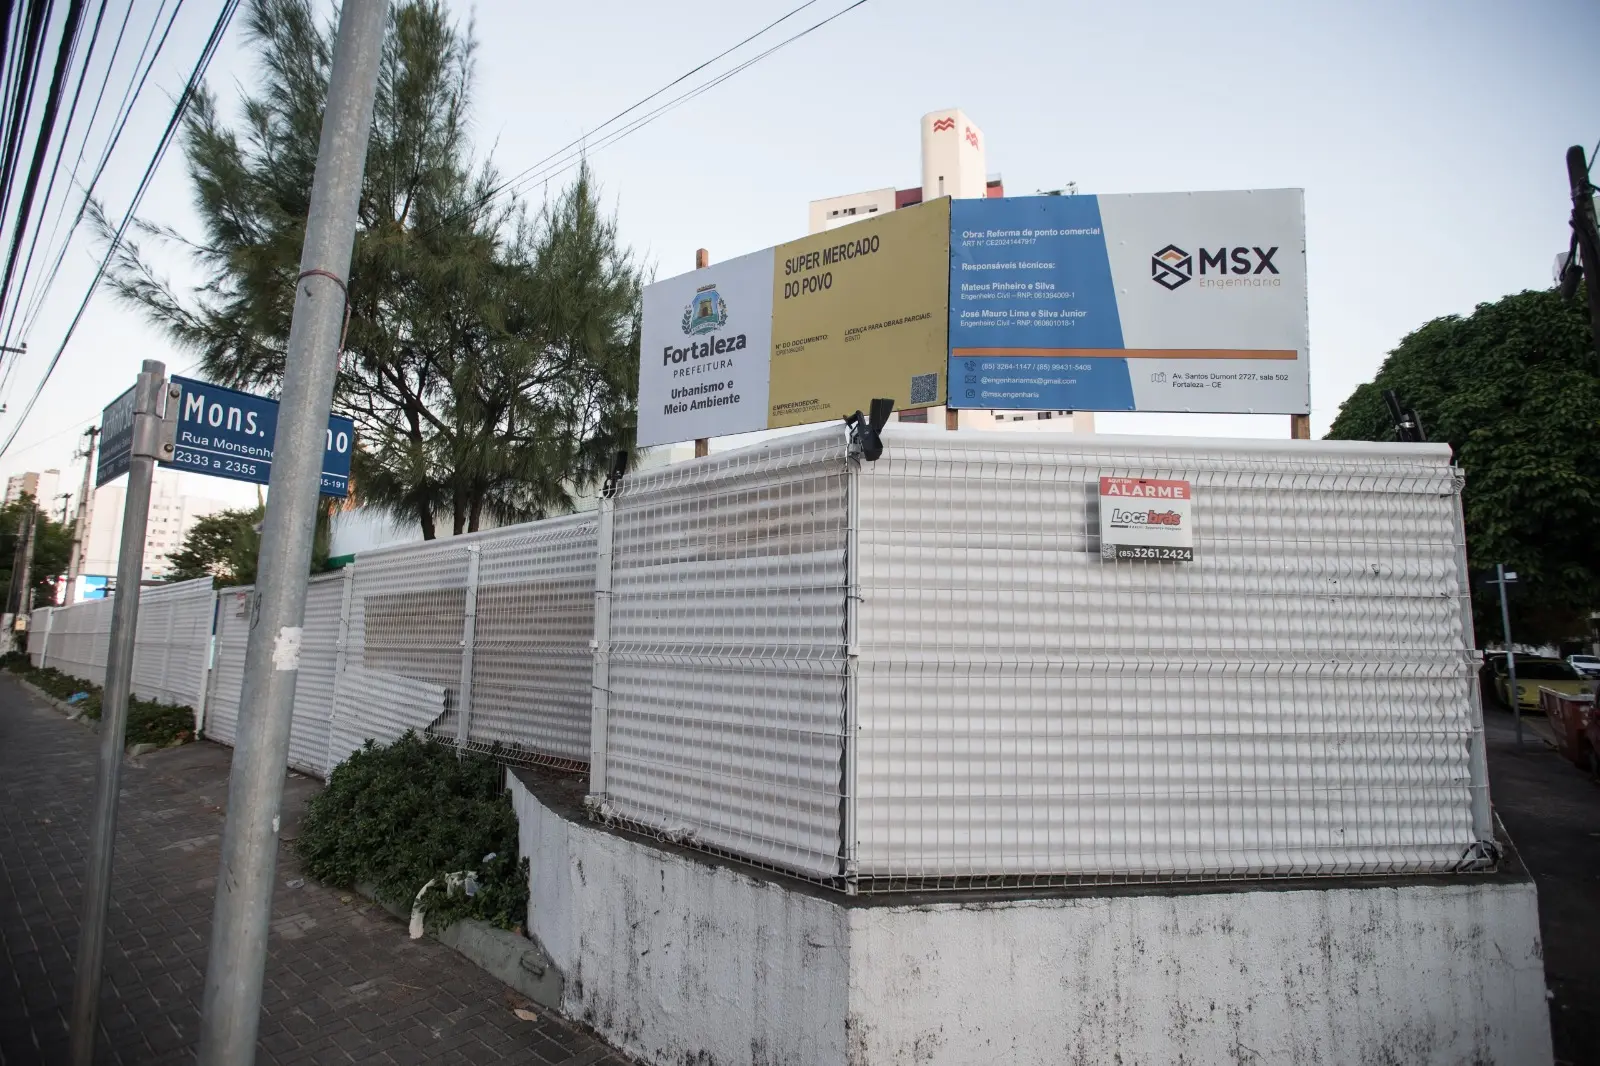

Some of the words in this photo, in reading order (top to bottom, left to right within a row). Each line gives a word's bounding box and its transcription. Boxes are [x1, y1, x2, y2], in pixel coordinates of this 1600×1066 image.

[962, 230, 984, 238] Obra:
[987, 229, 1020, 237] Reforma
[1034, 228, 1058, 238] ponto
[1060, 227, 1100, 236] comercial
[785, 251, 820, 276] SUPER
[823, 235, 880, 266] MERCADO
[1199, 246, 1280, 275] MSX
[962, 261, 1017, 271] Responsáveis
[1019, 261, 1056, 269] técnicos:
[784, 280, 800, 299] DO
[802, 272, 832, 295] POVO
[961, 283, 990, 291] Mateus
[992, 282, 1026, 290] Pinheiro
[1035, 282, 1055, 290] Silva
[1200, 277, 1281, 289] Engenharia
[960, 309, 980, 318] José
[981, 310, 1007, 318] Mauro
[1038, 309, 1058, 318] Silva
[844, 325, 867, 336] LICENÇA
[868, 322, 883, 332] PARA
[884, 318, 903, 328] OBRAS
[904, 312, 932, 323] PARCIAIS:
[792, 334, 829, 346] DOCUMENTO:
[663, 334, 747, 366] Fortaleza
[673, 359, 733, 378] PREFEITURA
[1239, 373, 1258, 381] 2727,
[671, 382, 724, 399] Urbanismo
[727, 380, 733, 388] e
[664, 402, 688, 415] Meio
[690, 393, 740, 411] Ambiente
[184, 392, 265, 438] Mons.
[182, 432, 209, 446] Rua
[176, 451, 209, 466] 2333
[213, 460, 221, 468] a
[225, 461, 257, 475] 2355
[1108, 484, 1184, 498] ALARME
[1112, 508, 1181, 525] Locabrás
